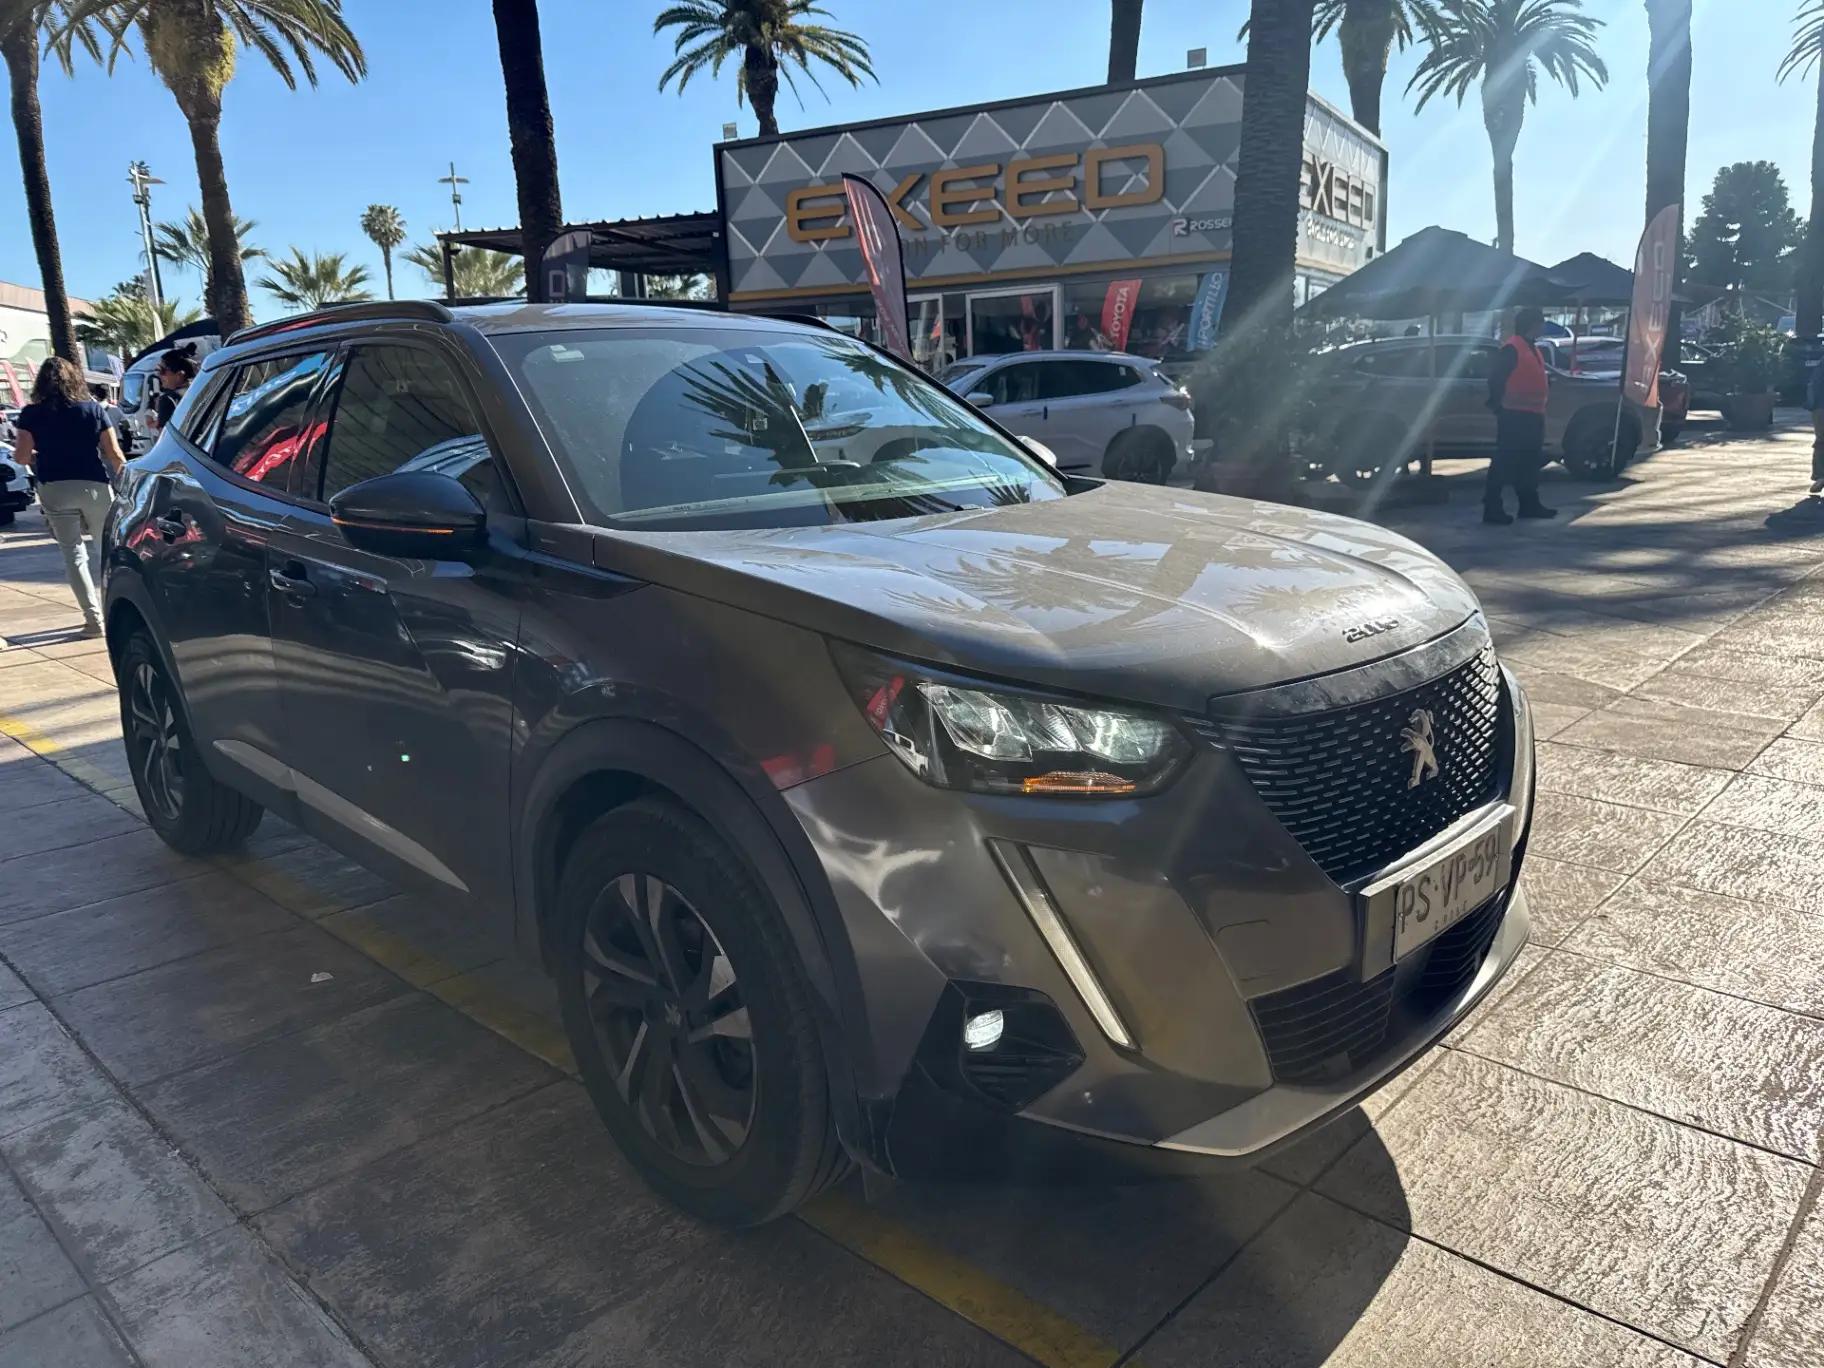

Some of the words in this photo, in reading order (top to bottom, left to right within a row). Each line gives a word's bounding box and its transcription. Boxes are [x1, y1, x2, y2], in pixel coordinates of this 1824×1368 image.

[940, 231, 987, 253] FOR
[1001, 221, 1073, 249] MORE
[1109, 287, 1130, 338] TOYOTA
